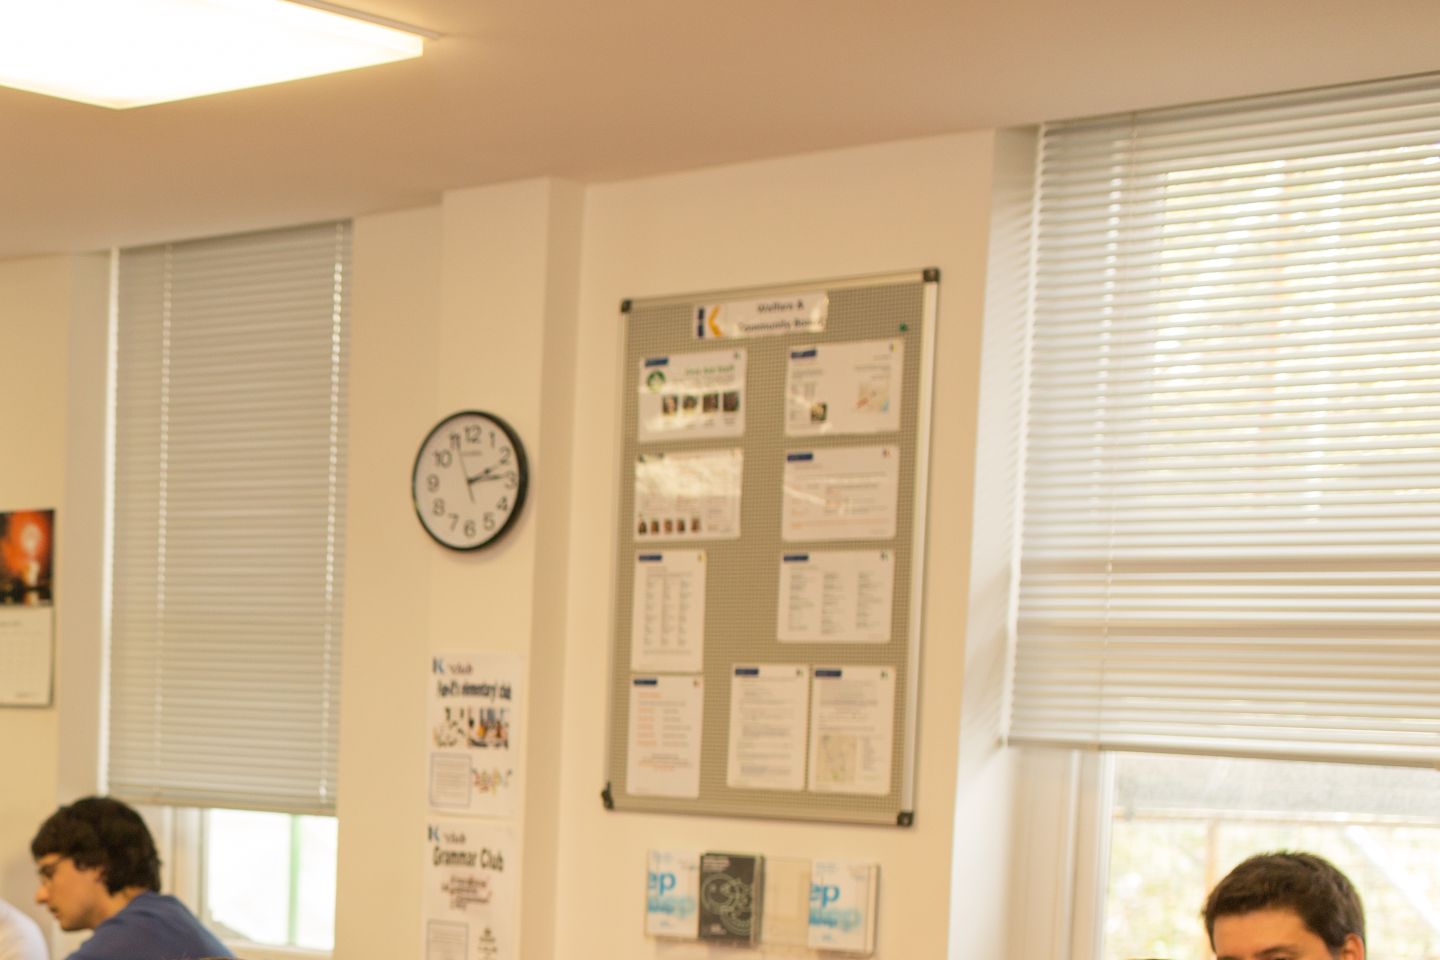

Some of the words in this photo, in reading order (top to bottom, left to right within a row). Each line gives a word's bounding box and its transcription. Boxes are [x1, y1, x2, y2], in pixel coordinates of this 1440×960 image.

[464, 424, 481, 444] 12
[433, 449, 453, 468] 10
[500, 445, 511, 465] 2
[427, 473, 440, 493] 9
[504, 470, 517, 490] 3
[433, 498, 445, 517] 8
[497, 496, 508, 512] 4
[449, 512, 459, 532] 7
[464, 519, 476, 538] 6
[483, 511, 495, 530] 5
[480, 848, 503, 871] Club
